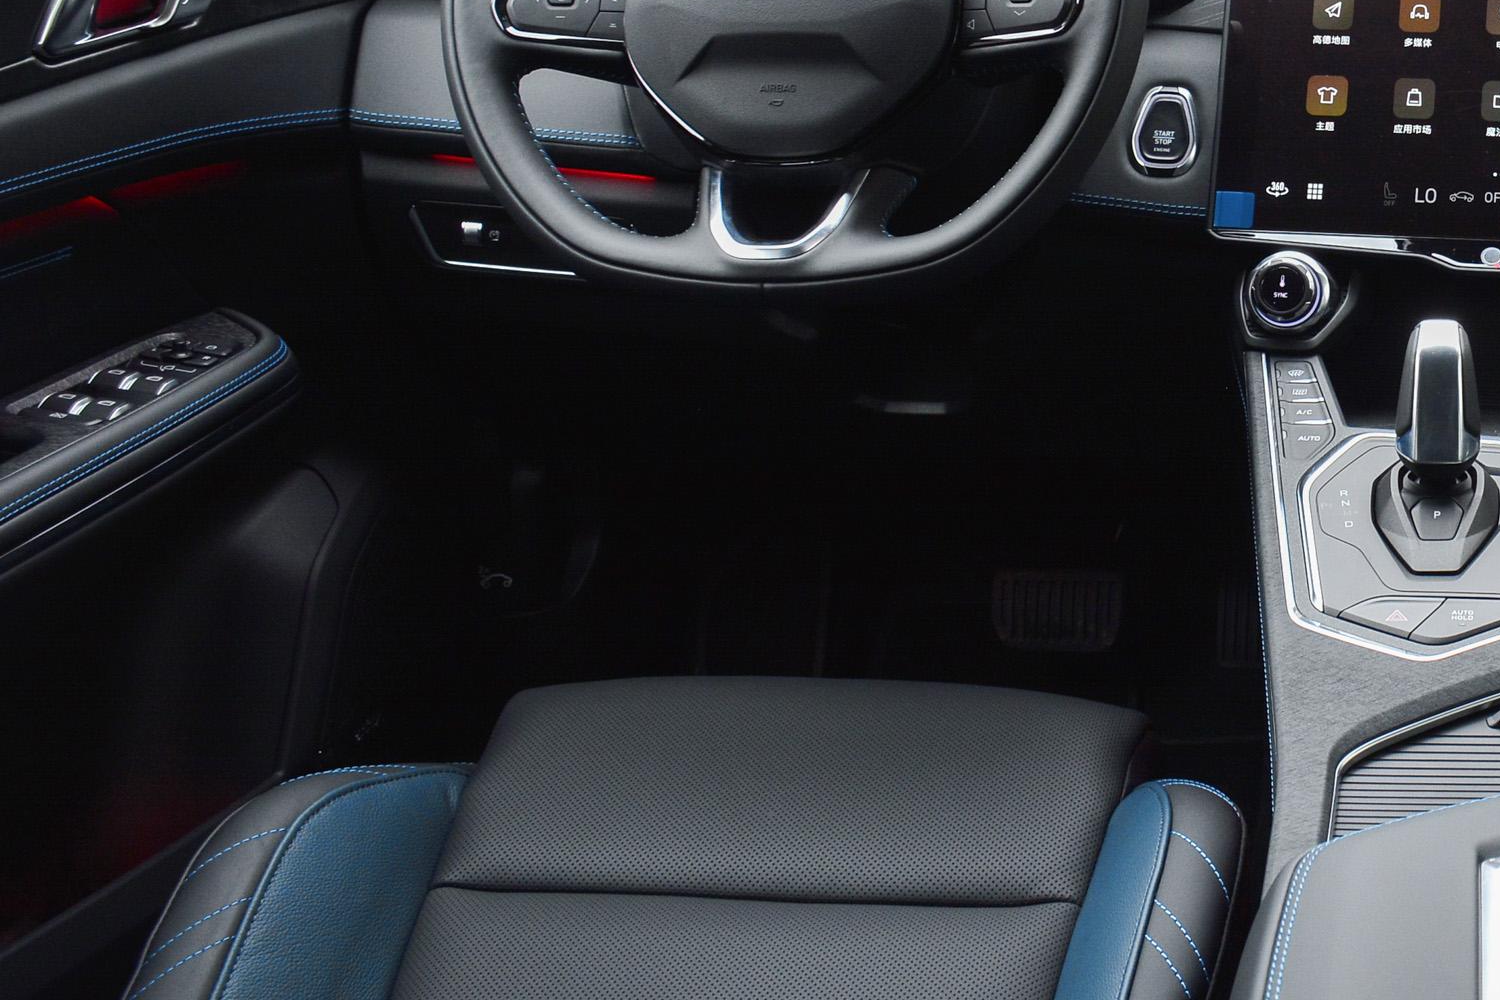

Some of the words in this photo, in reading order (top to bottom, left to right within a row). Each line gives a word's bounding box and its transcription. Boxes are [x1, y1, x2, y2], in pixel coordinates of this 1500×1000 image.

[1312, 35, 1351, 46] 高德地图
[1404, 37, 1433, 48] 多媒体
[760, 84, 797, 93] AIRBAG
[1315, 121, 1335, 132] 主题
[1393, 124, 1432, 135] 应用市场
[1154, 130, 1175, 138] START
[1414, 188, 1437, 204] LO
[1433, 510, 1441, 519] P
